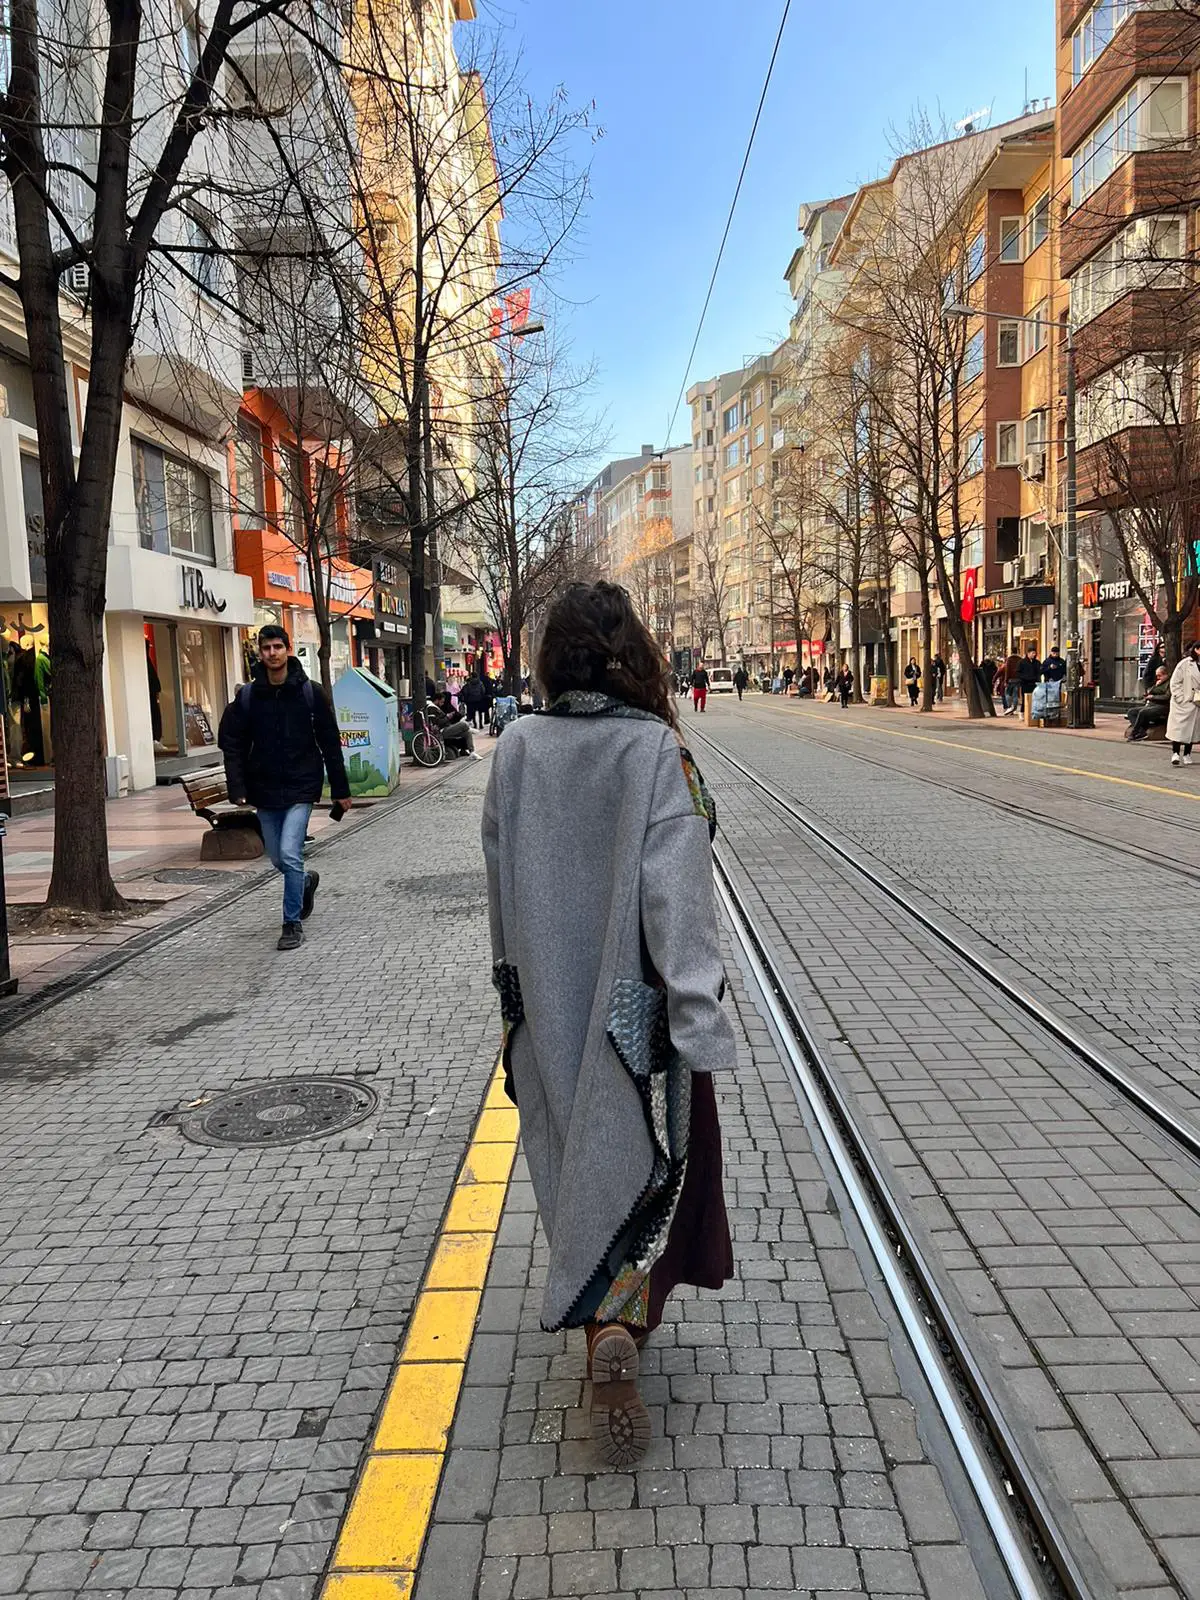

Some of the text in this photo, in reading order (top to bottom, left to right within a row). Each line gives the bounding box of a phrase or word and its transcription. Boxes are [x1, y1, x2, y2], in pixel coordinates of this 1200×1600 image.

[180, 564, 206, 609] LTB
[271, 572, 291, 586] SAMSUNG
[1083, 580, 1131, 607] IN STREET
